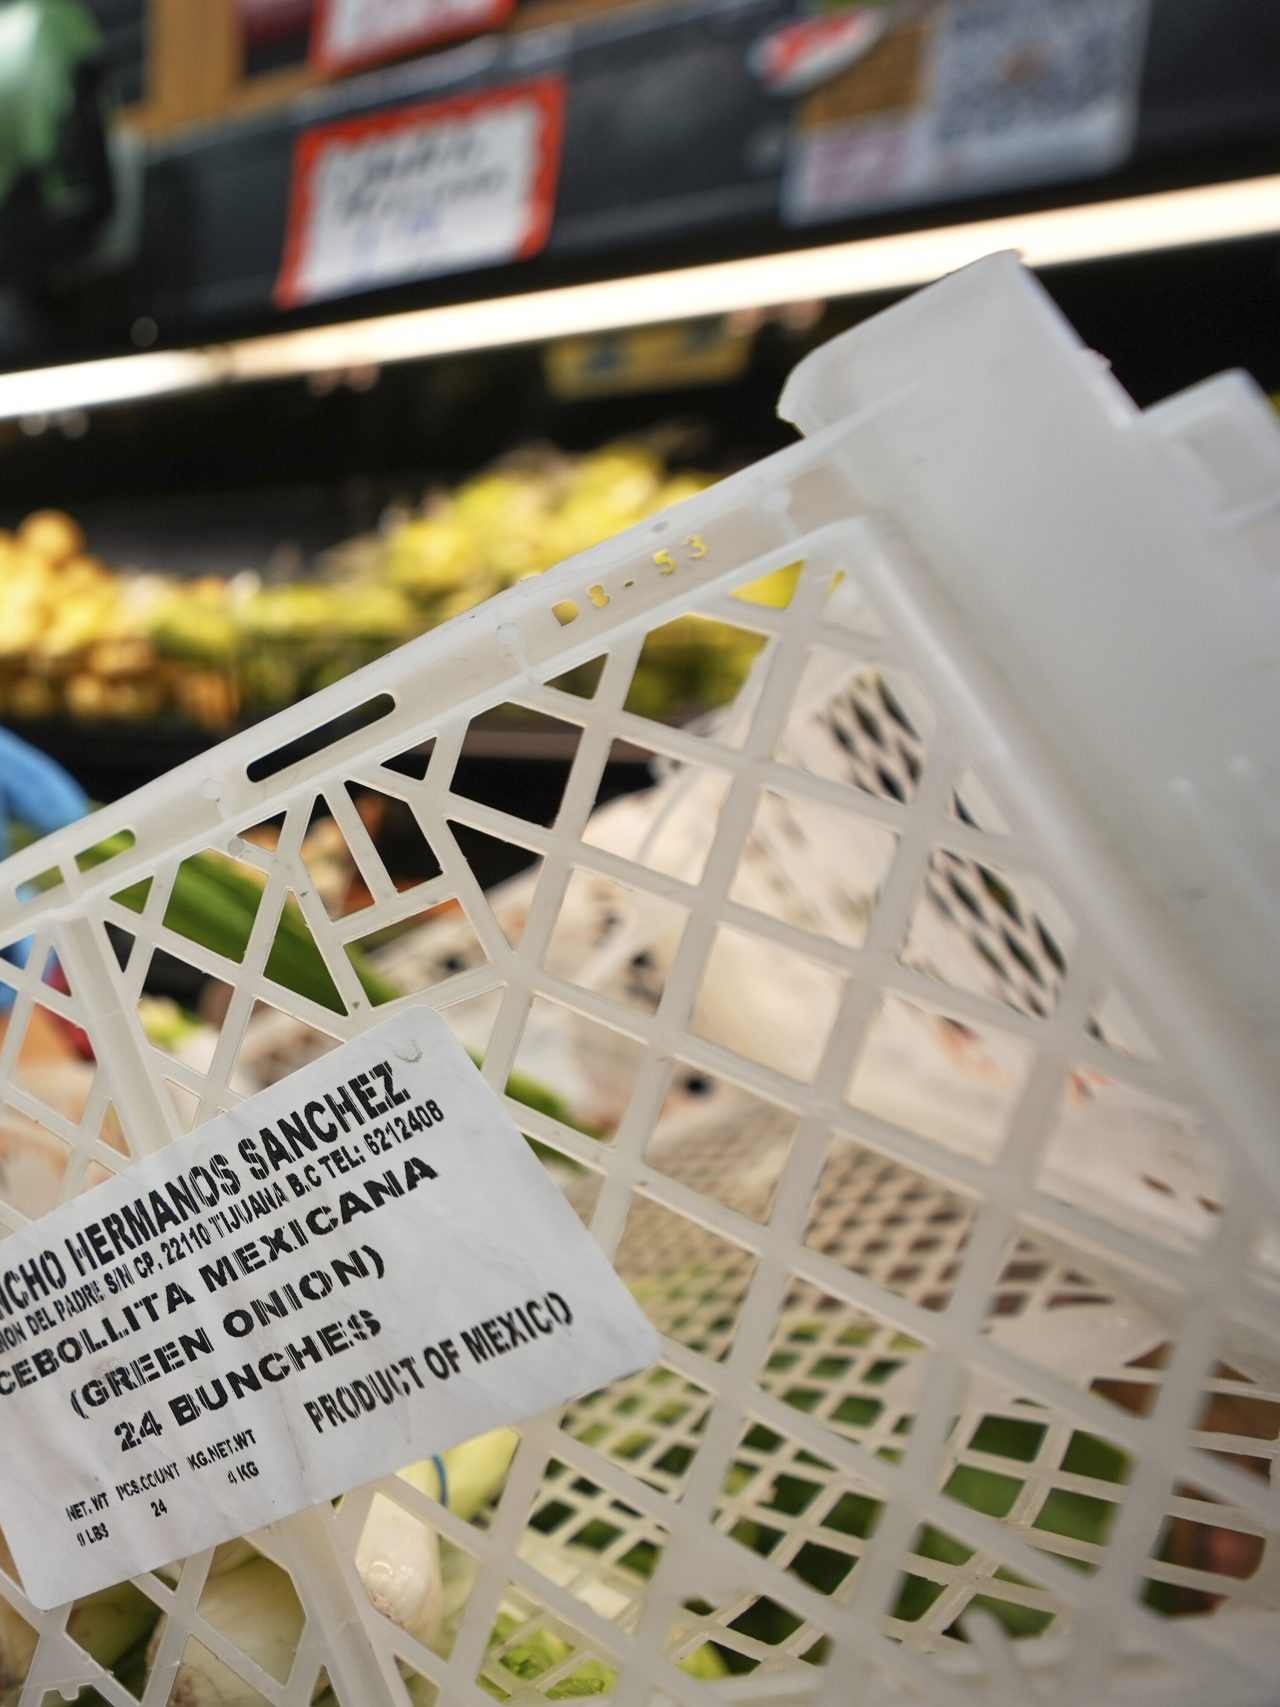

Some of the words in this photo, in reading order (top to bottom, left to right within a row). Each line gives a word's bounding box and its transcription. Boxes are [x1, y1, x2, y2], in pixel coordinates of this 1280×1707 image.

[25, 1306, 56, 1336] DEL
[53, 1280, 105, 1321] PADRE
[160, 1223, 211, 1266] 22110
[208, 1182, 289, 1238] TIJUANA
[317, 1145, 366, 1178] TEL:
[363, 1099, 444, 1156] 6212408
[64, 1154, 241, 1276] HERMANOS
[237, 1061, 412, 1180] SANCHEZ
[198, 1157, 440, 1293] MEXICANA
[70, 1327, 214, 1419] (GREEN
[223, 1245, 385, 1338] ONION)
[114, 1410, 163, 1451] 24
[168, 1309, 381, 1427] BUNCHES
[303, 1356, 425, 1433] PRODUCT
[423, 1338, 461, 1380] OF
[459, 1291, 574, 1365] MEXICO
[150, 1499, 168, 1518] 24
[237, 1461, 260, 1482] KG
